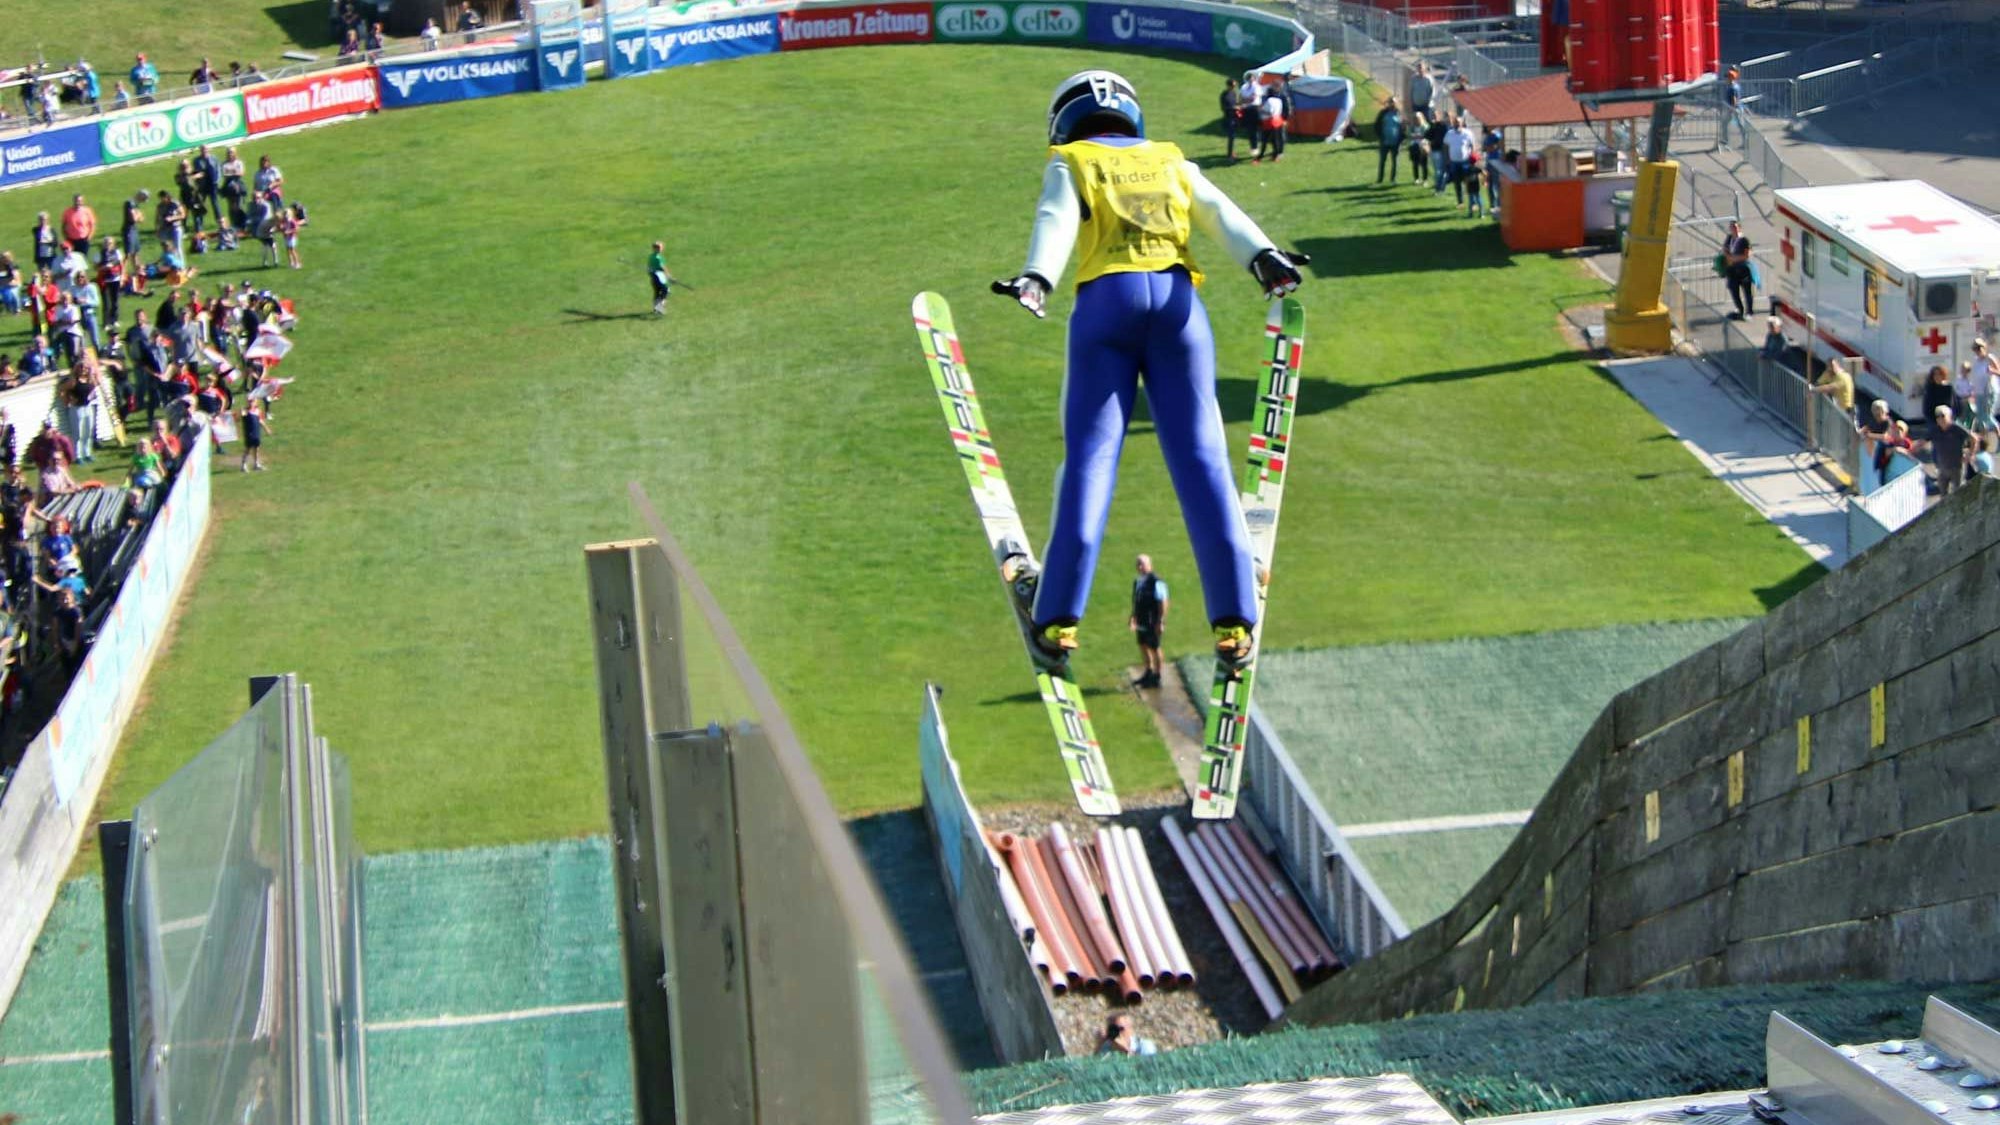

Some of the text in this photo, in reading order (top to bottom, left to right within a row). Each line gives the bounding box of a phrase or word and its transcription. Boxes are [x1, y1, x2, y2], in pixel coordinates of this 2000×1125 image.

[677, 20, 772, 46] VOLKSBANK
[782, 9, 928, 41] Kronen Zeitung
[1137, 15, 1167, 28] Union
[1137, 28, 1194, 43] Investment
[422, 58, 529, 83] VOLKSBANK
[246, 77, 375, 123] Kronen Zeitung
[6, 145, 43, 161] Union
[7, 151, 76, 174] Investment
